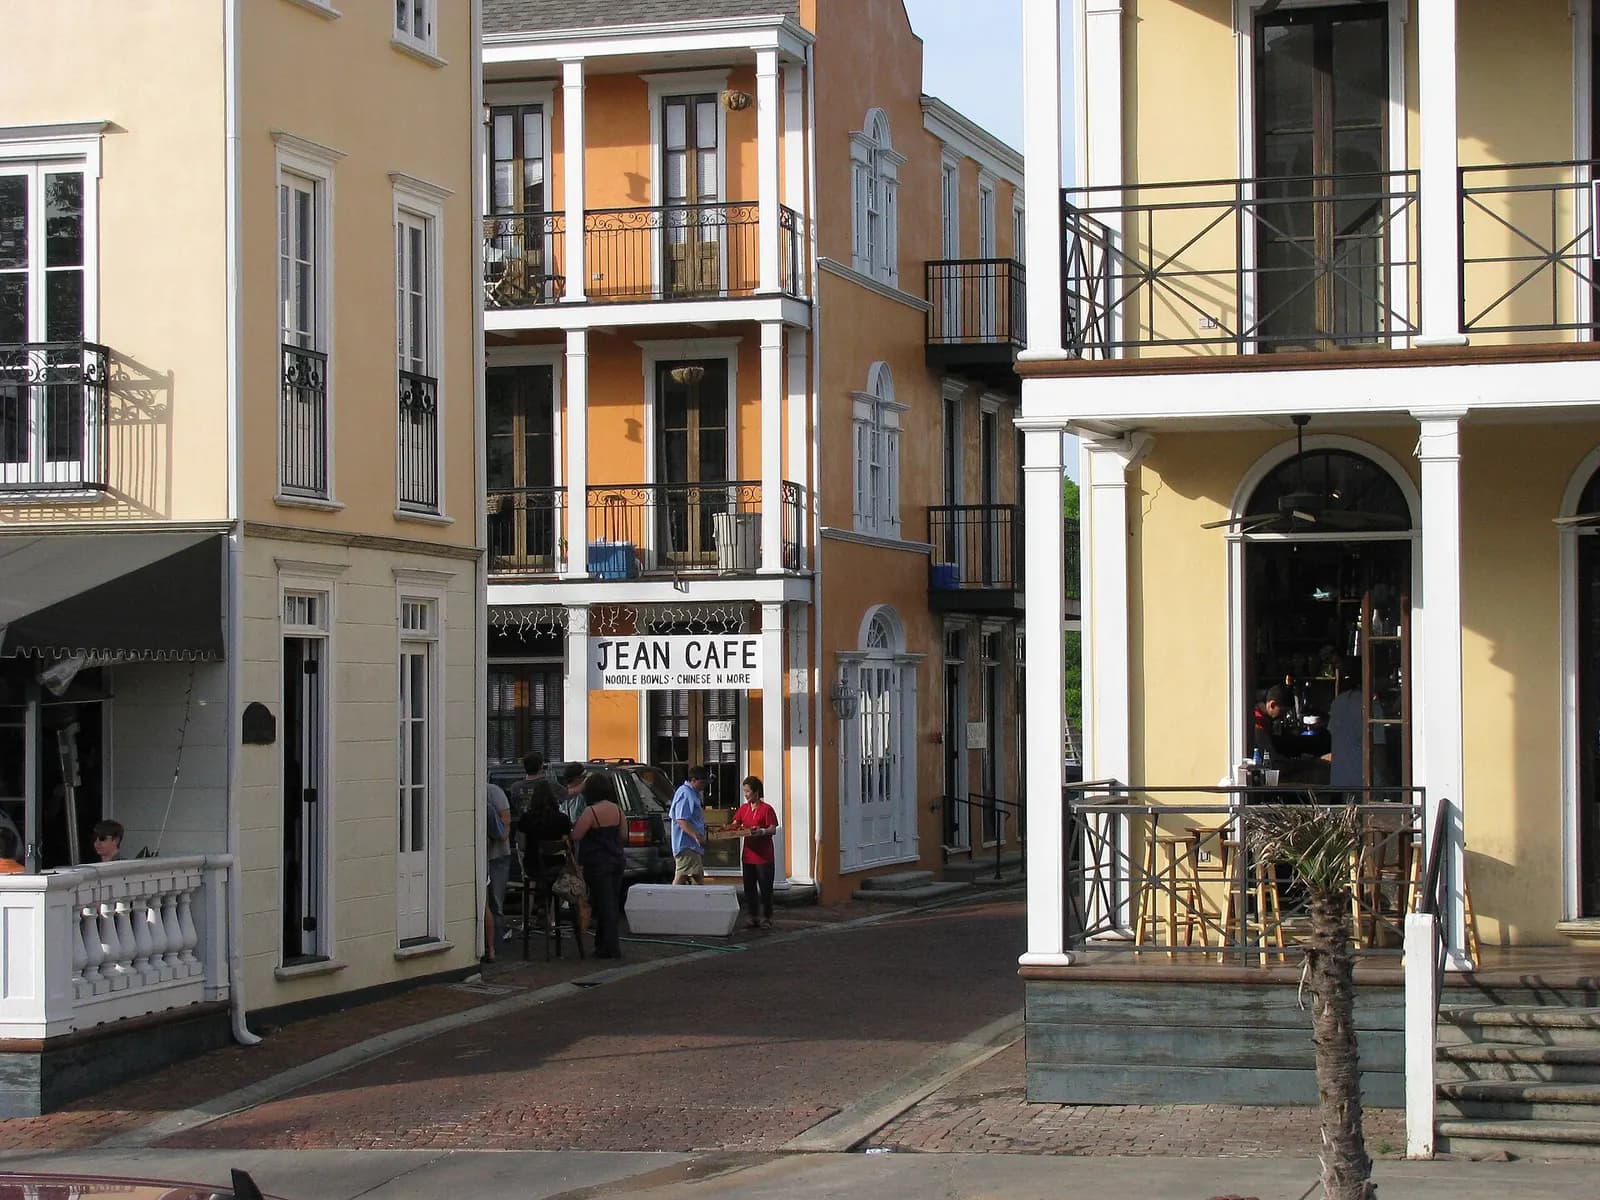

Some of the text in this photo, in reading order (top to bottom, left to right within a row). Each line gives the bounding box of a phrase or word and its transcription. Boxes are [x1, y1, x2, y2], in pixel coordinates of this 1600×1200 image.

[597, 641, 757, 670] JEAN CAFE
[605, 673, 751, 685] NOODLE BOWLS CHINESE N MORE
